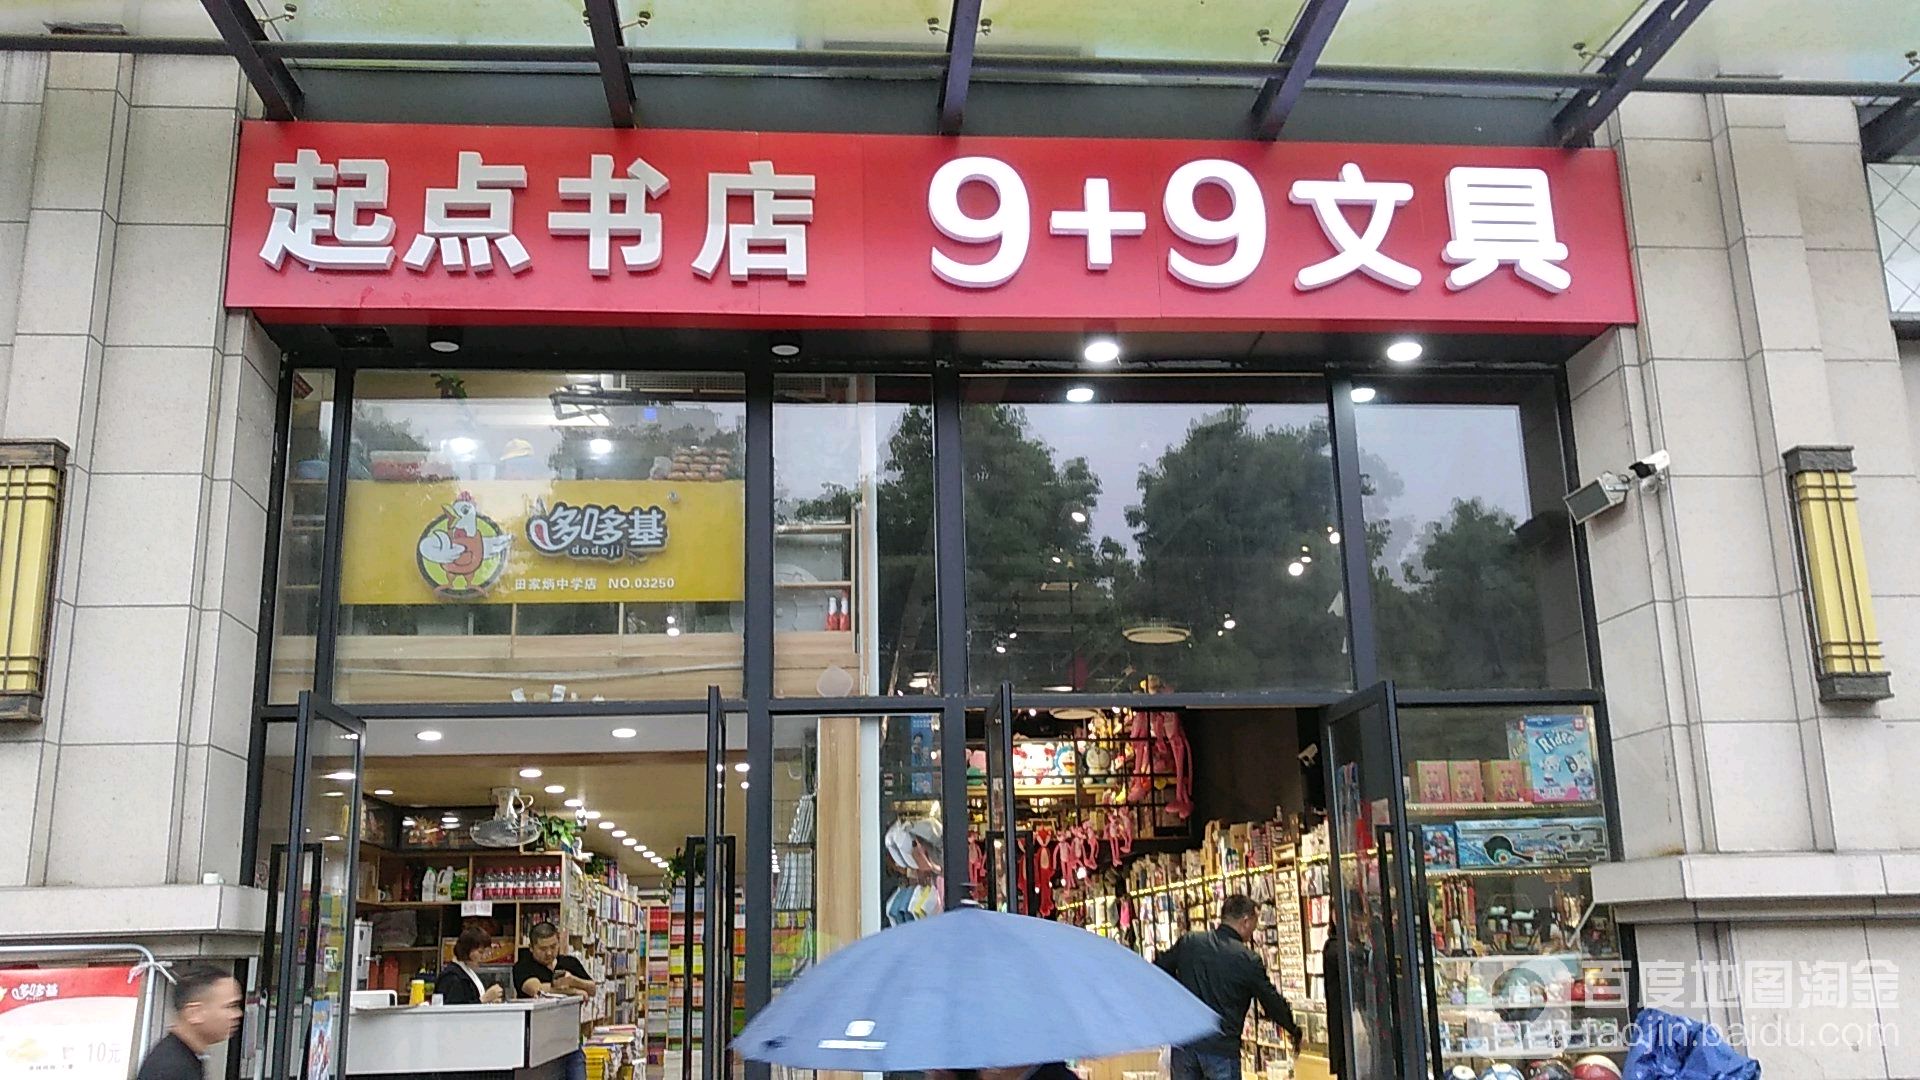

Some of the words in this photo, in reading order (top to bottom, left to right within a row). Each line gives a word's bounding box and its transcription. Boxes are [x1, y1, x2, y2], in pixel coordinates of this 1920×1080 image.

[259, 148, 816, 284] 起点书店
[928, 156, 1572, 295] 9+9文具
[528, 504, 665, 552] 多哆基
[571, 545, 621, 558] dodoji
[608, 576, 676, 590] NO.03250
